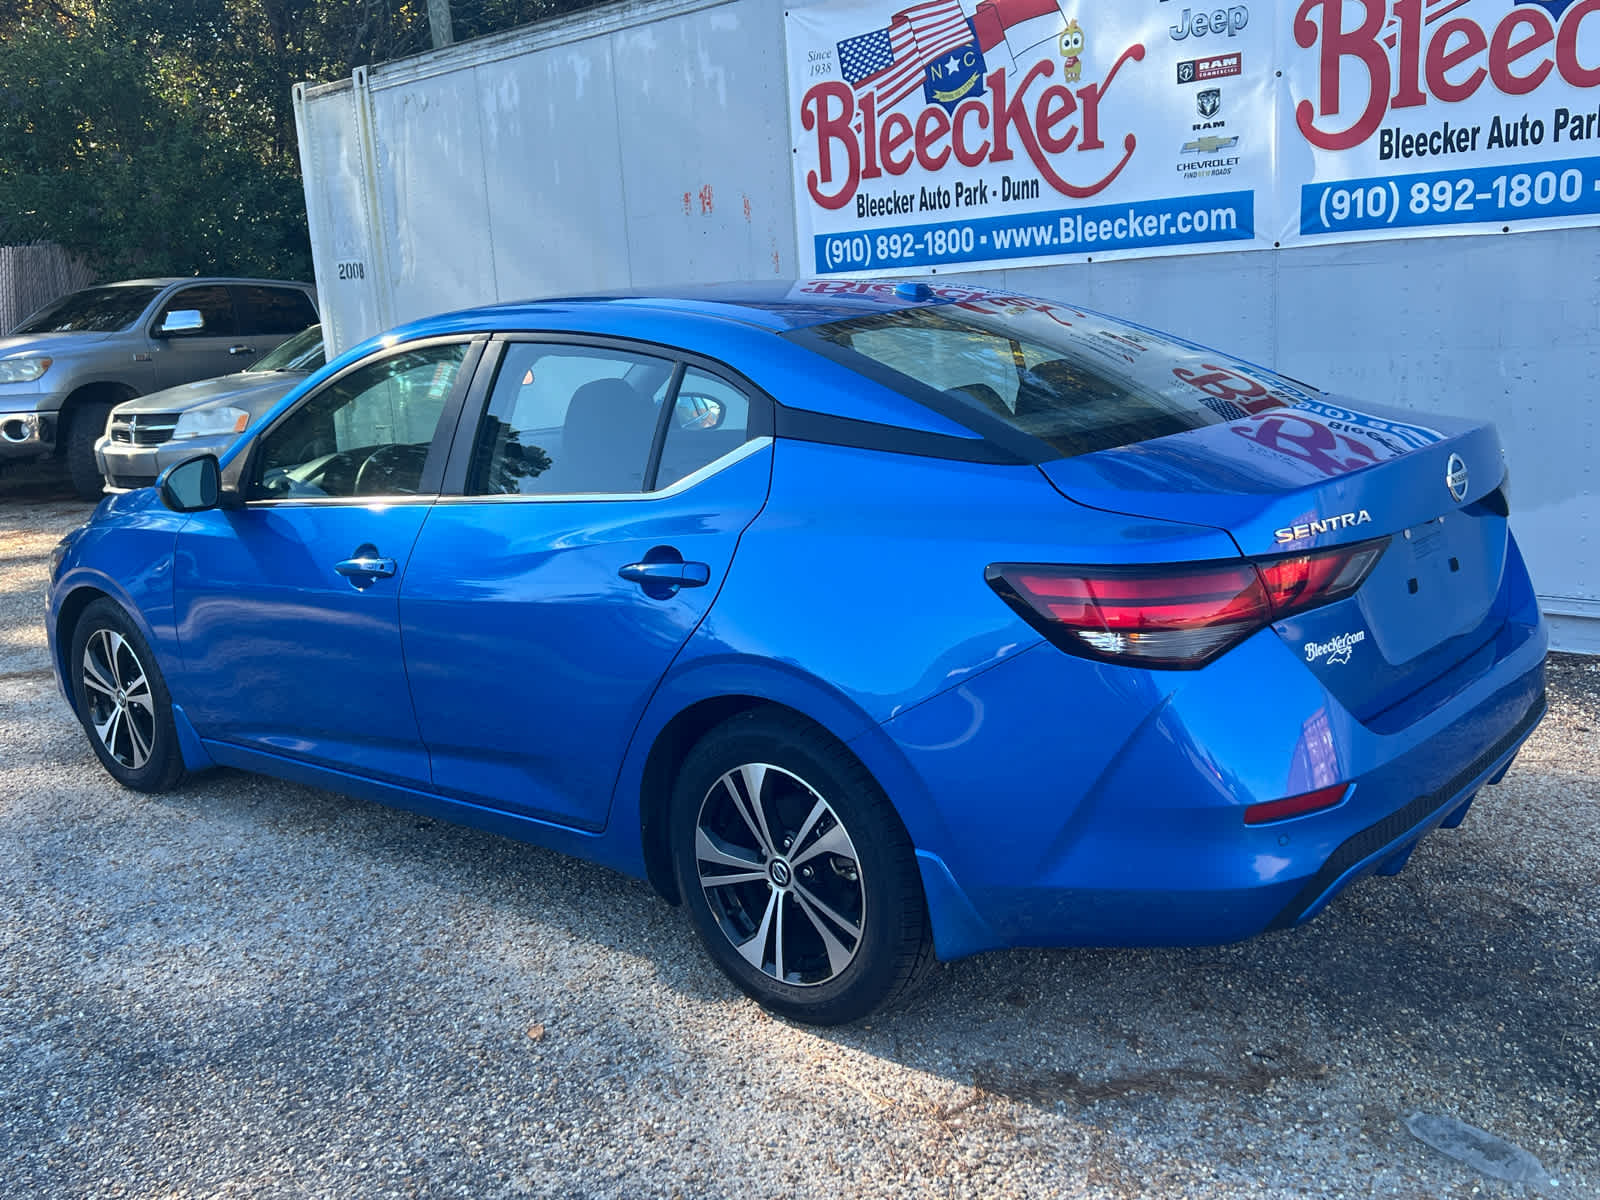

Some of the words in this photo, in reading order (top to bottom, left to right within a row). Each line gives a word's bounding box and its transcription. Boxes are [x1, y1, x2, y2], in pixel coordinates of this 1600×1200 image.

[1169, 5, 1249, 41] Jeep
[808, 50, 832, 62] Since
[810, 62, 832, 77] 1938
[930, 63, 943, 82] N
[963, 51, 976, 67] C
[1199, 57, 1238, 70] RAM
[801, 43, 1146, 211] Bleecker
[1192, 120, 1225, 131] RAM
[1379, 121, 1481, 161] Bleecker
[1487, 113, 1545, 149] Auto
[1553, 104, 1600, 143] Par
[1176, 156, 1240, 172] CHEVROLET
[1211, 167, 1232, 177] ROADS
[856, 190, 915, 219] Bleecker
[918, 186, 950, 212] Auto
[955, 179, 989, 208] Park
[1002, 175, 1040, 203] Dunn
[1319, 181, 1400, 227] (910)
[1410, 168, 1583, 214] 892-1800
[825, 233, 872, 268] (910)
[876, 227, 975, 261] 892-1800
[992, 205, 1237, 250] www.Bleecker.com
[338, 263, 364, 280] 2008
[1274, 510, 1373, 544] SENTRA
